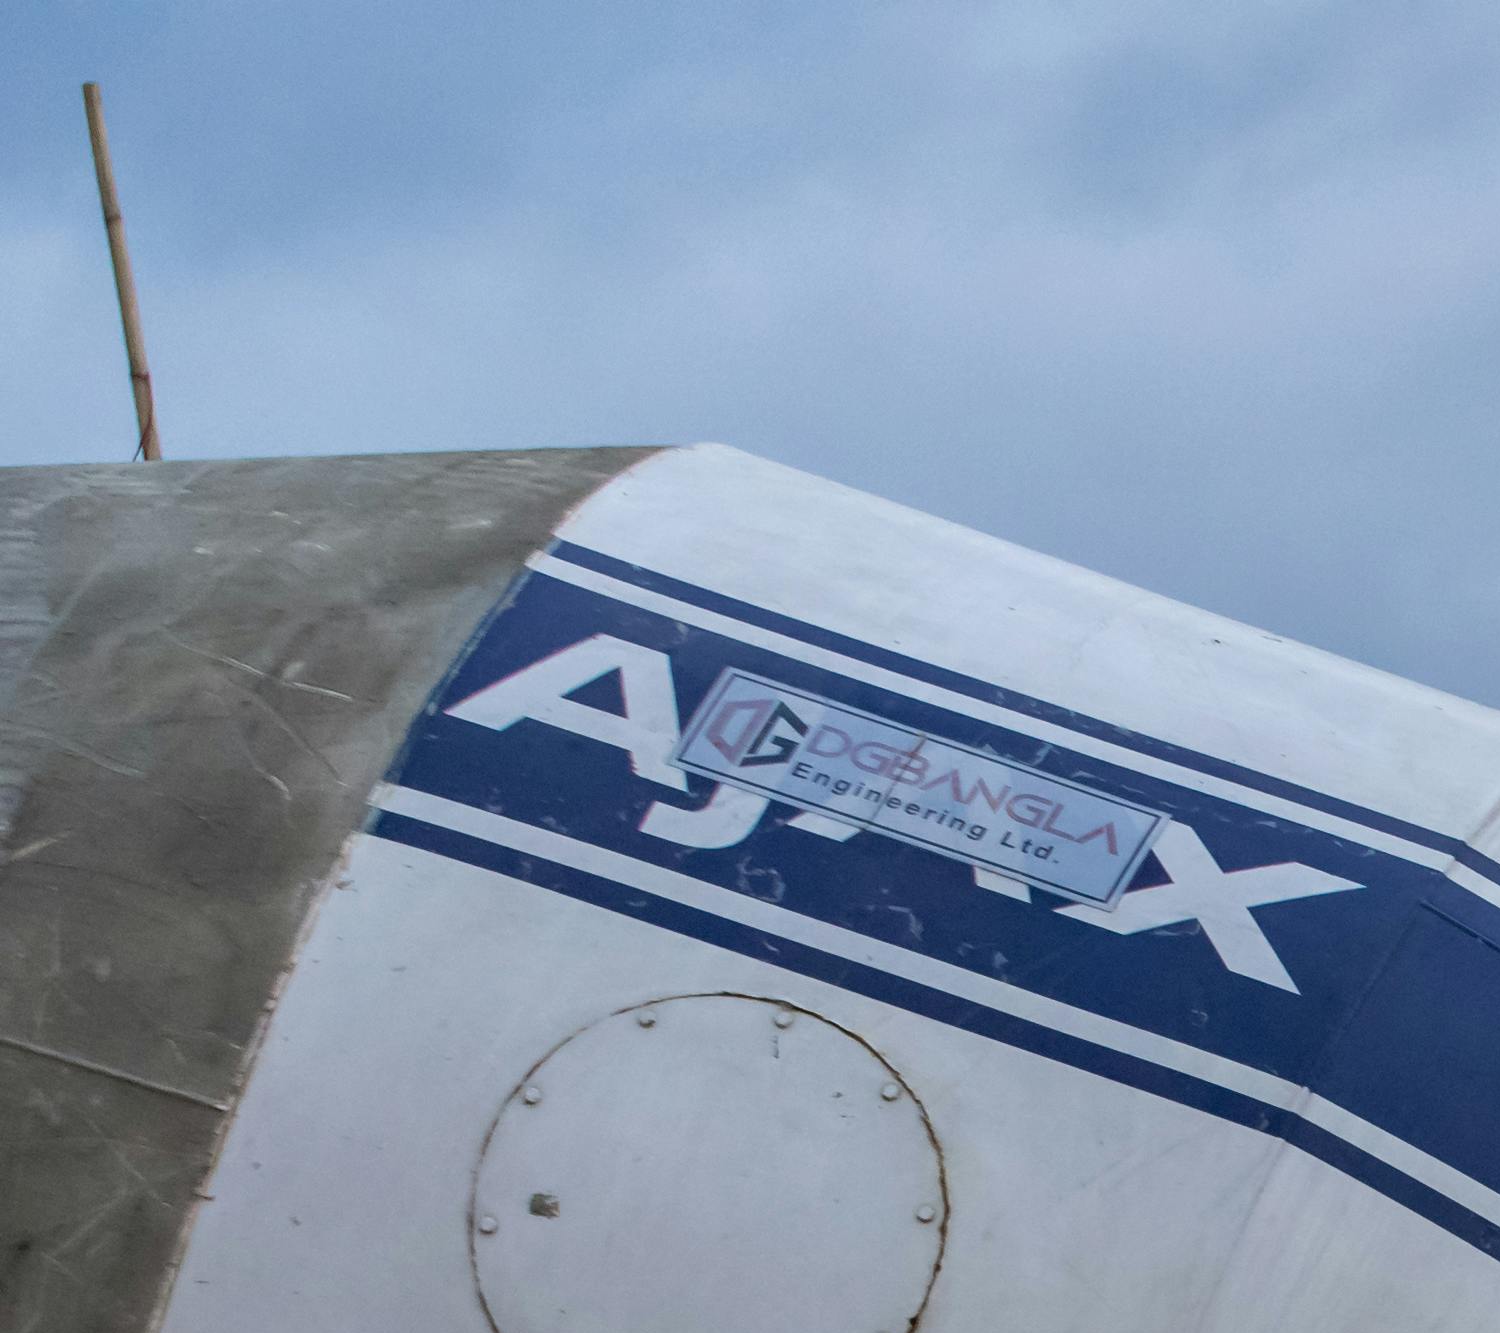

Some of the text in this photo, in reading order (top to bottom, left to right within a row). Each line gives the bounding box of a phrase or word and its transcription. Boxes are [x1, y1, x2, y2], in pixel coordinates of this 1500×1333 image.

[790, 761, 1061, 866] Engineering Ltd.
[803, 723, 1120, 856] DGBANGLA
